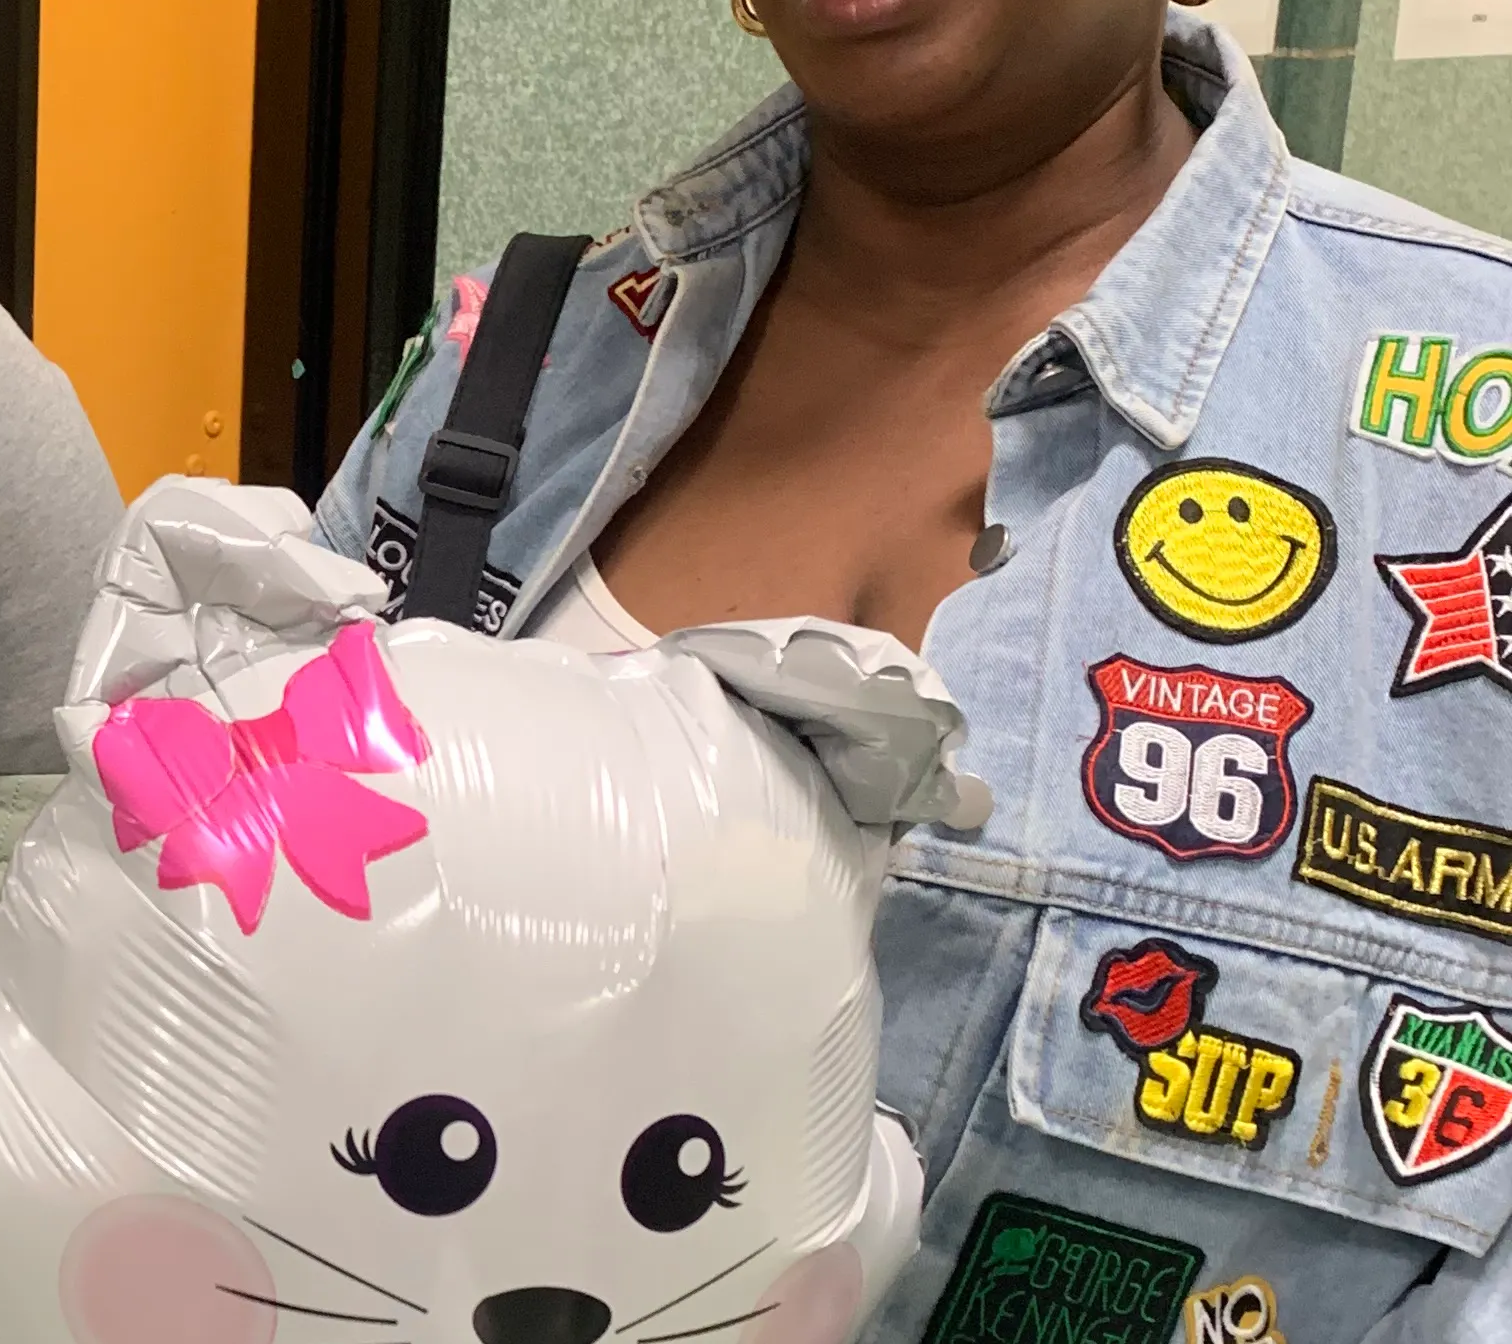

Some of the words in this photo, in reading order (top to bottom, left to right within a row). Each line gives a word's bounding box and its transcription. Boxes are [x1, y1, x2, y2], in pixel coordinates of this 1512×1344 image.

[1119, 668, 1281, 726] VINTAGE
[1113, 721, 1269, 845] 96
[1030, 1233, 1177, 1323] GEORGE
